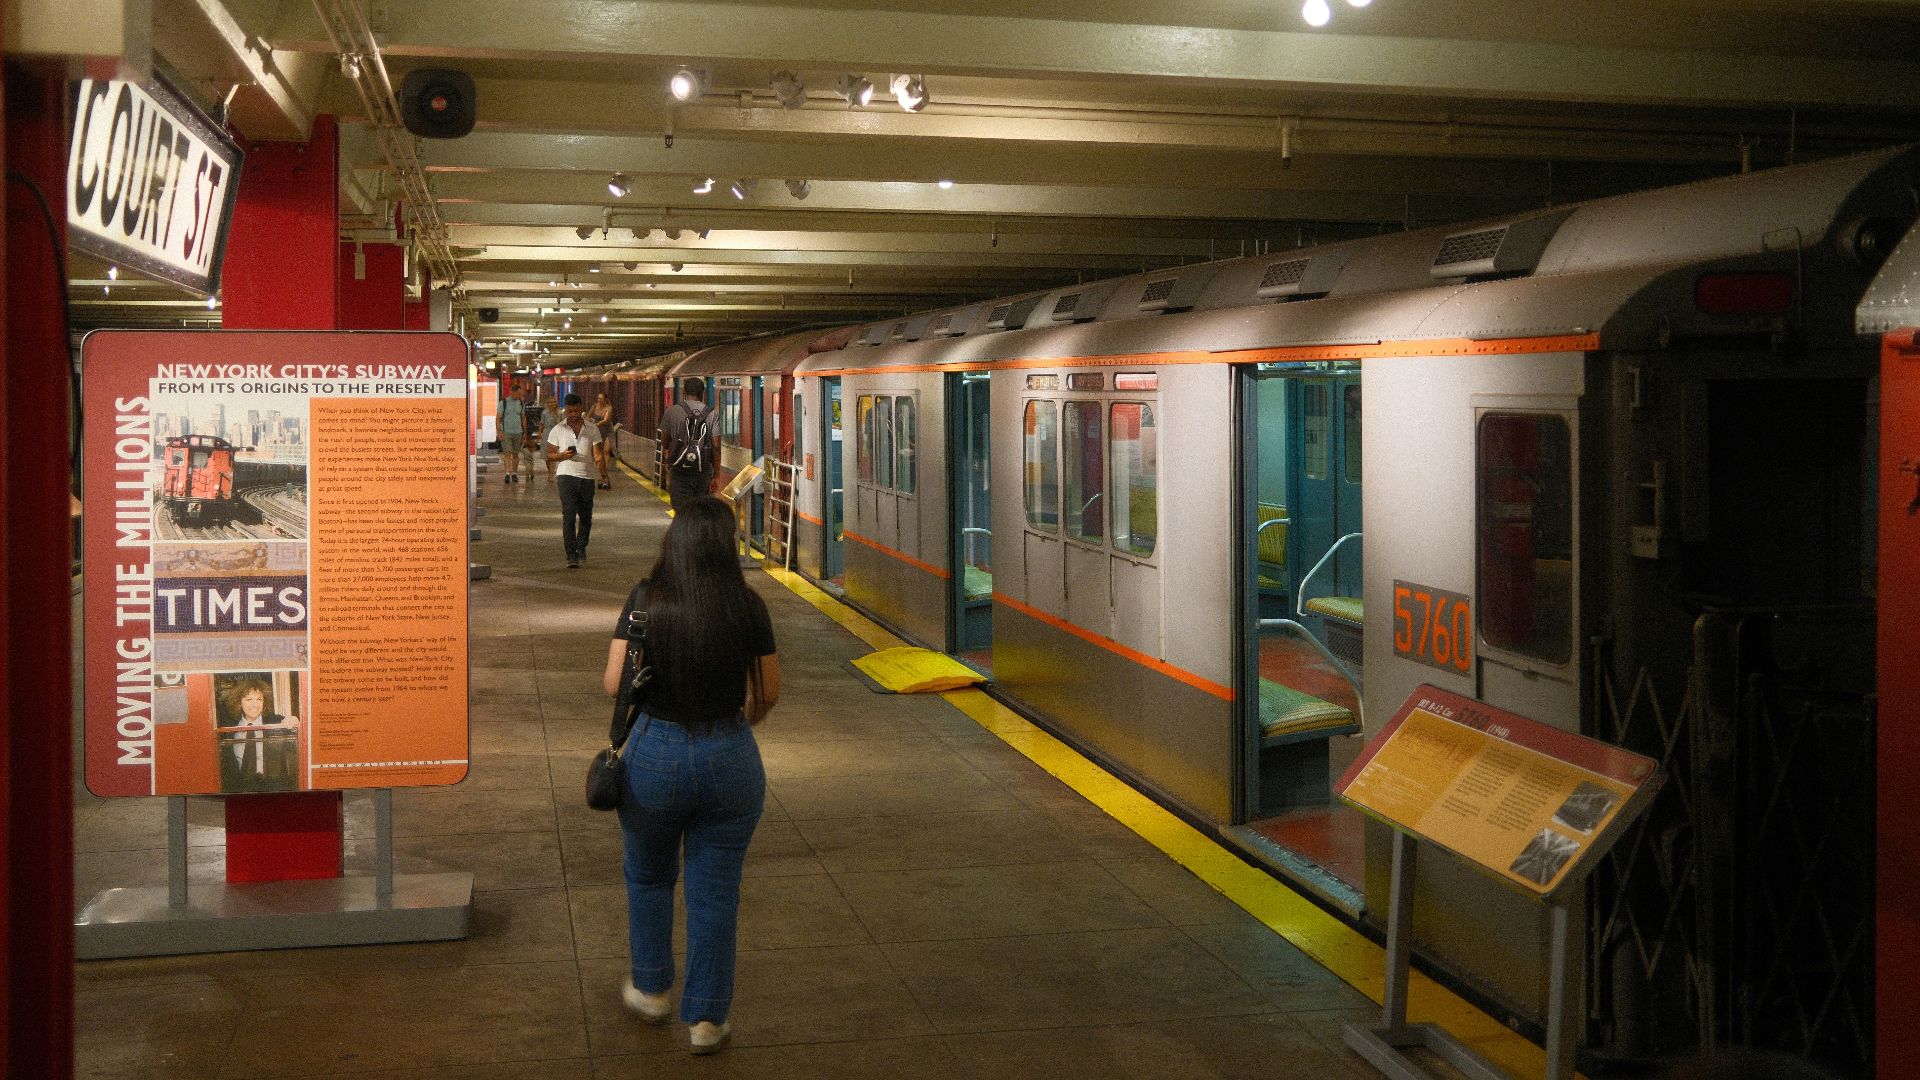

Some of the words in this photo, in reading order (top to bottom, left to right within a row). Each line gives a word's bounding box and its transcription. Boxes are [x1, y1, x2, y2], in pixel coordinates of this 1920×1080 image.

[75, 79, 190, 250] COURT
[157, 363, 212, 379] NEW
[214, 364, 274, 379] YORK
[280, 364, 349, 379] CITY'S
[355, 364, 446, 379] SUBWAY
[158, 382, 205, 394] FROM
[210, 382, 236, 394] ITS
[241, 382, 309, 394] ORIGINS
[312, 383, 335, 394] TO
[338, 383, 370, 394] THE
[375, 383, 446, 394] PRESENT
[115, 396, 150, 547] MILLIONS
[116, 563, 150, 627] THE
[158, 586, 306, 629] TIMES
[1395, 587, 1470, 671] 5760
[116, 637, 151, 765] MOVING
